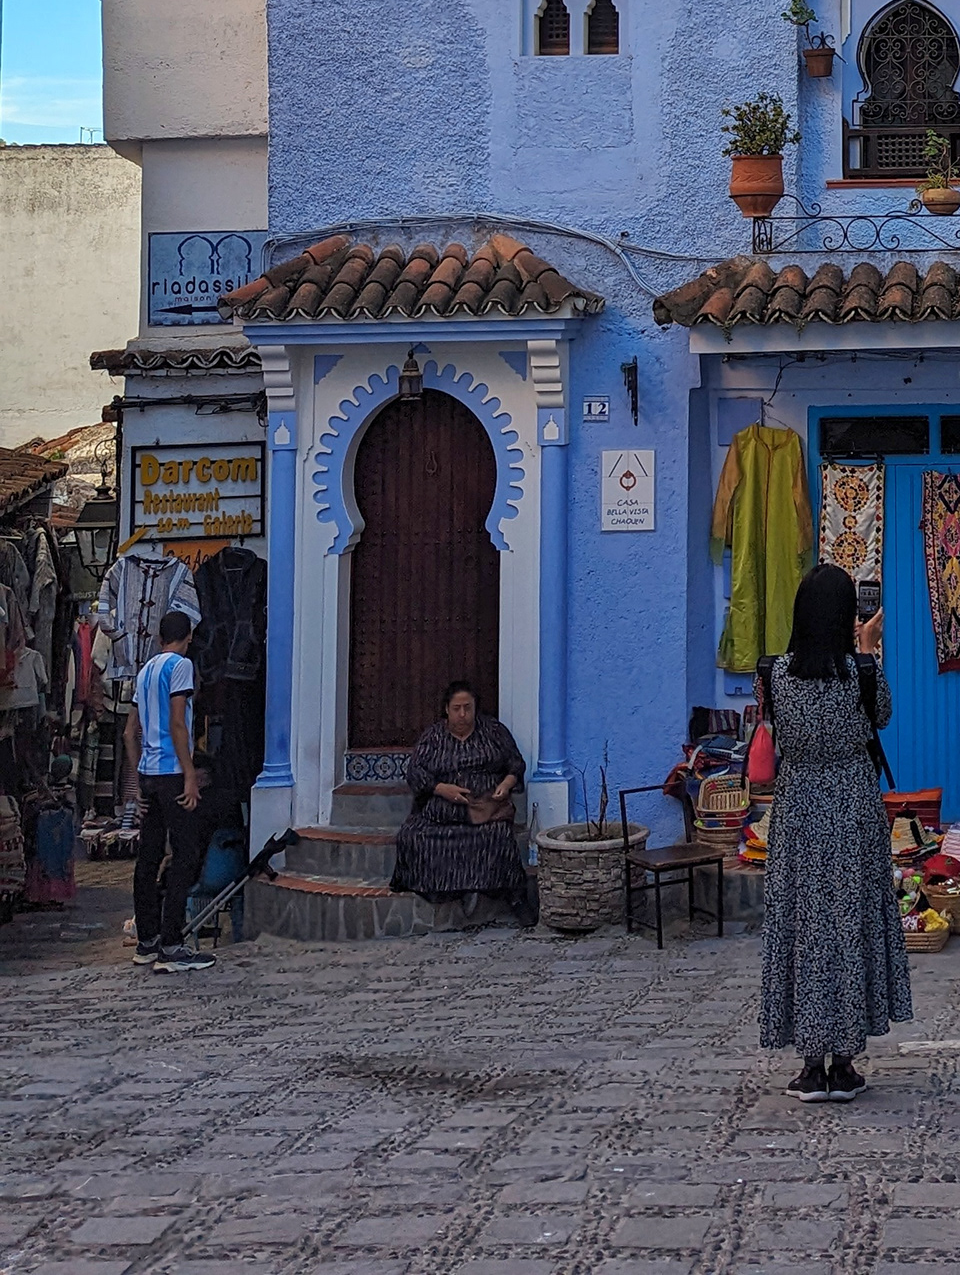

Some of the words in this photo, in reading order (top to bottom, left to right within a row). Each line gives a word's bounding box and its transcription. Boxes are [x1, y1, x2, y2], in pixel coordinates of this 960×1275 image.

[151, 274, 259, 296] riadassil
[585, 402, 607, 415] 12
[140, 453, 257, 486] Darcom
[143, 487, 221, 515] Restaurant
[616, 499, 639, 507] CASA
[606, 508, 627, 516] BELLA
[629, 507, 649, 515] VISTA
